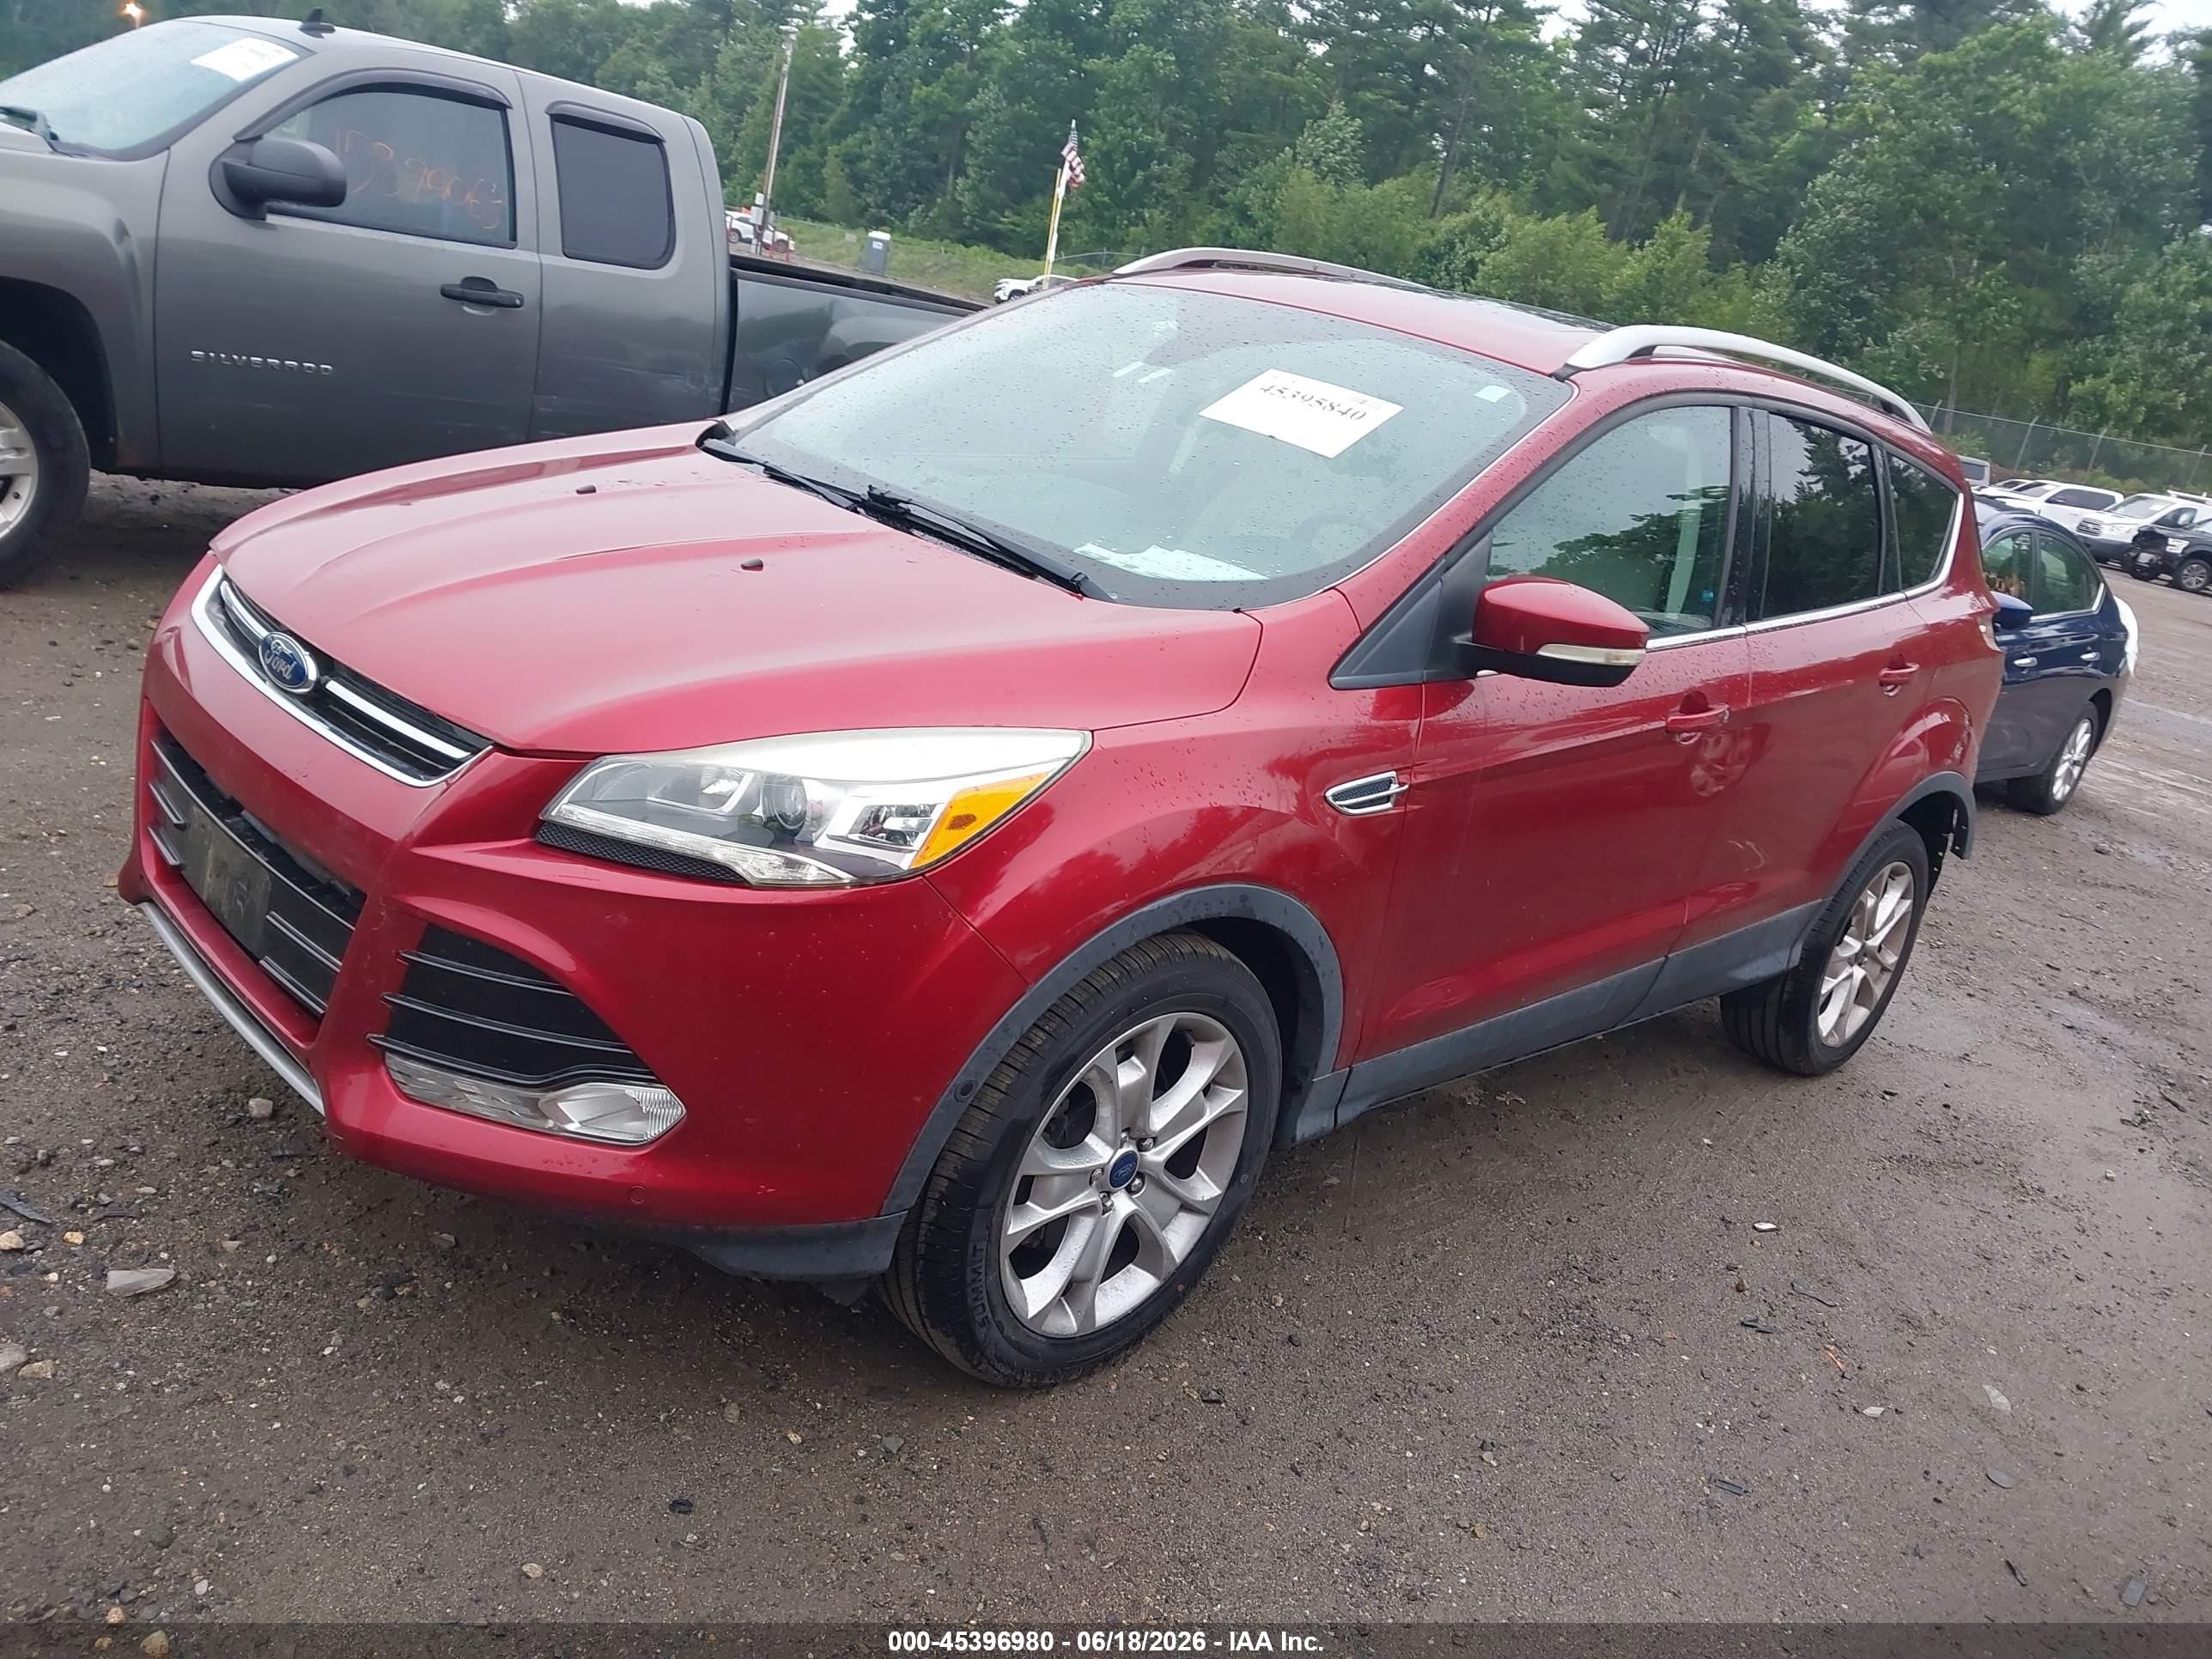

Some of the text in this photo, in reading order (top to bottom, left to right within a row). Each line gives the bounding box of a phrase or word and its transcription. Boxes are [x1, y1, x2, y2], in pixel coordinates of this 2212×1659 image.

[191, 349, 333, 376] SILVERADO
[1260, 385, 1367, 420] 45395840
[264, 639, 297, 680] Ford
[970, 1243, 990, 1328] SUMMIT
